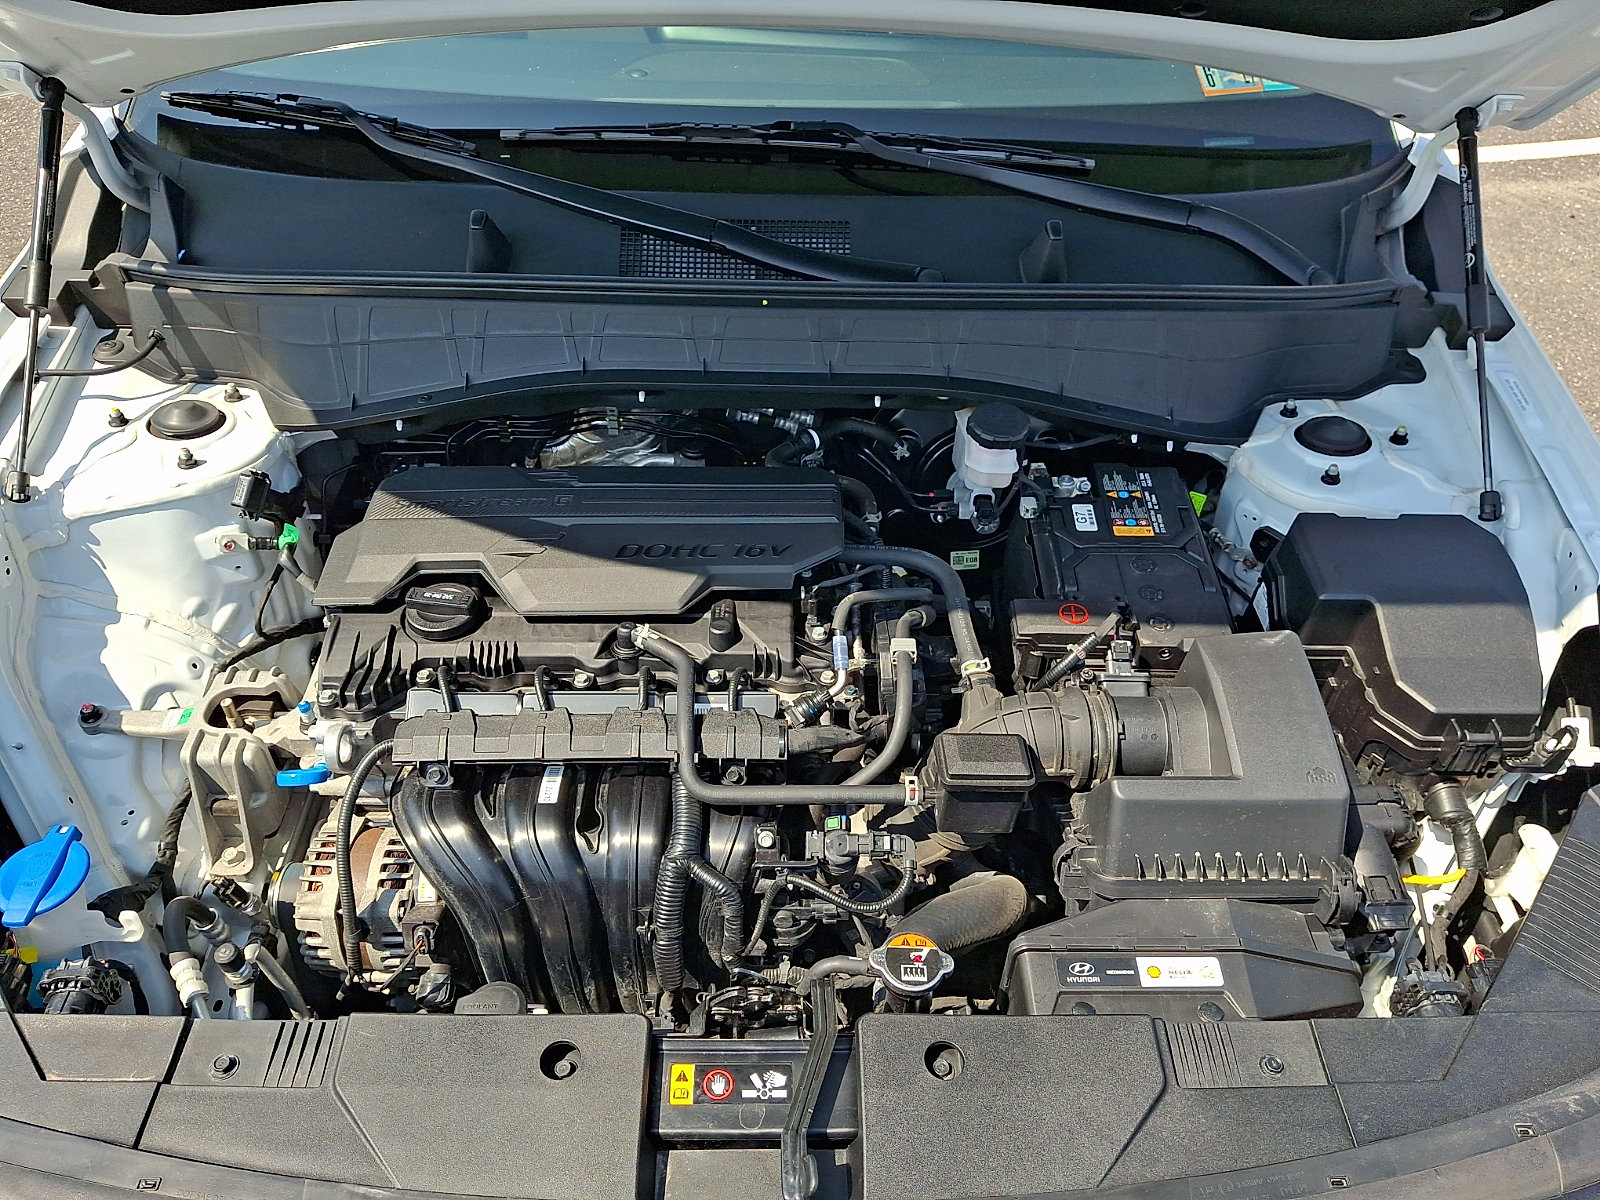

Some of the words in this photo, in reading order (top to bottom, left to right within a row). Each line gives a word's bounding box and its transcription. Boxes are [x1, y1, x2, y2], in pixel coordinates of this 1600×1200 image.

[1075, 511, 1088, 524] G7
[614, 543, 725, 559] DOHC
[732, 542, 794, 559] 16V
[462, 1002, 499, 1010] COOLANT
